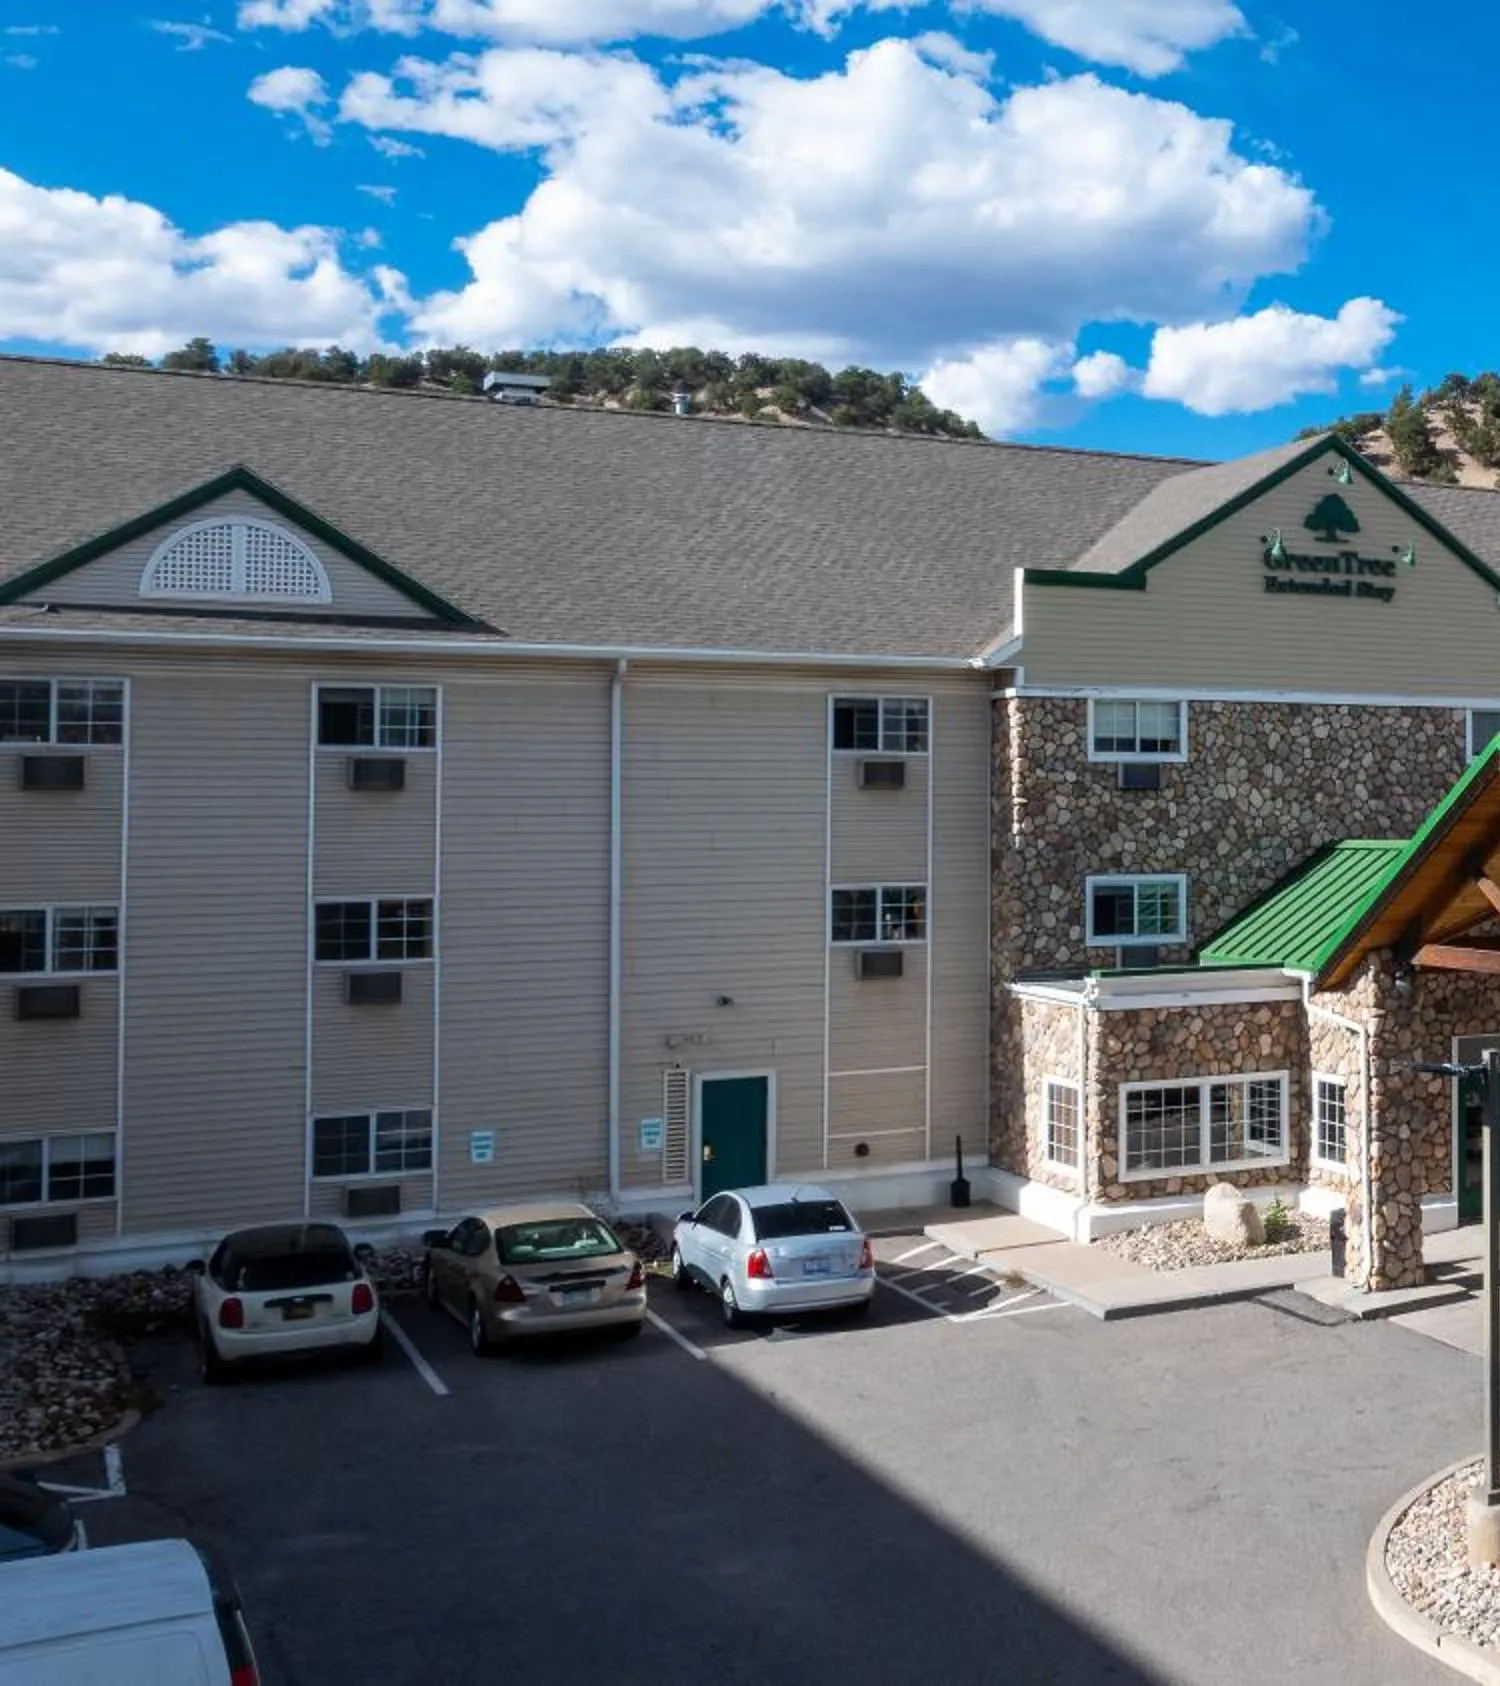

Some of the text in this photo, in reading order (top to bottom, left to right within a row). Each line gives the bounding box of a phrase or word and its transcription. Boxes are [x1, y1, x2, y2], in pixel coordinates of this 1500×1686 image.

[1264, 550, 1396, 577] GreenTree
[1264, 576, 1395, 602] Extended Stay
